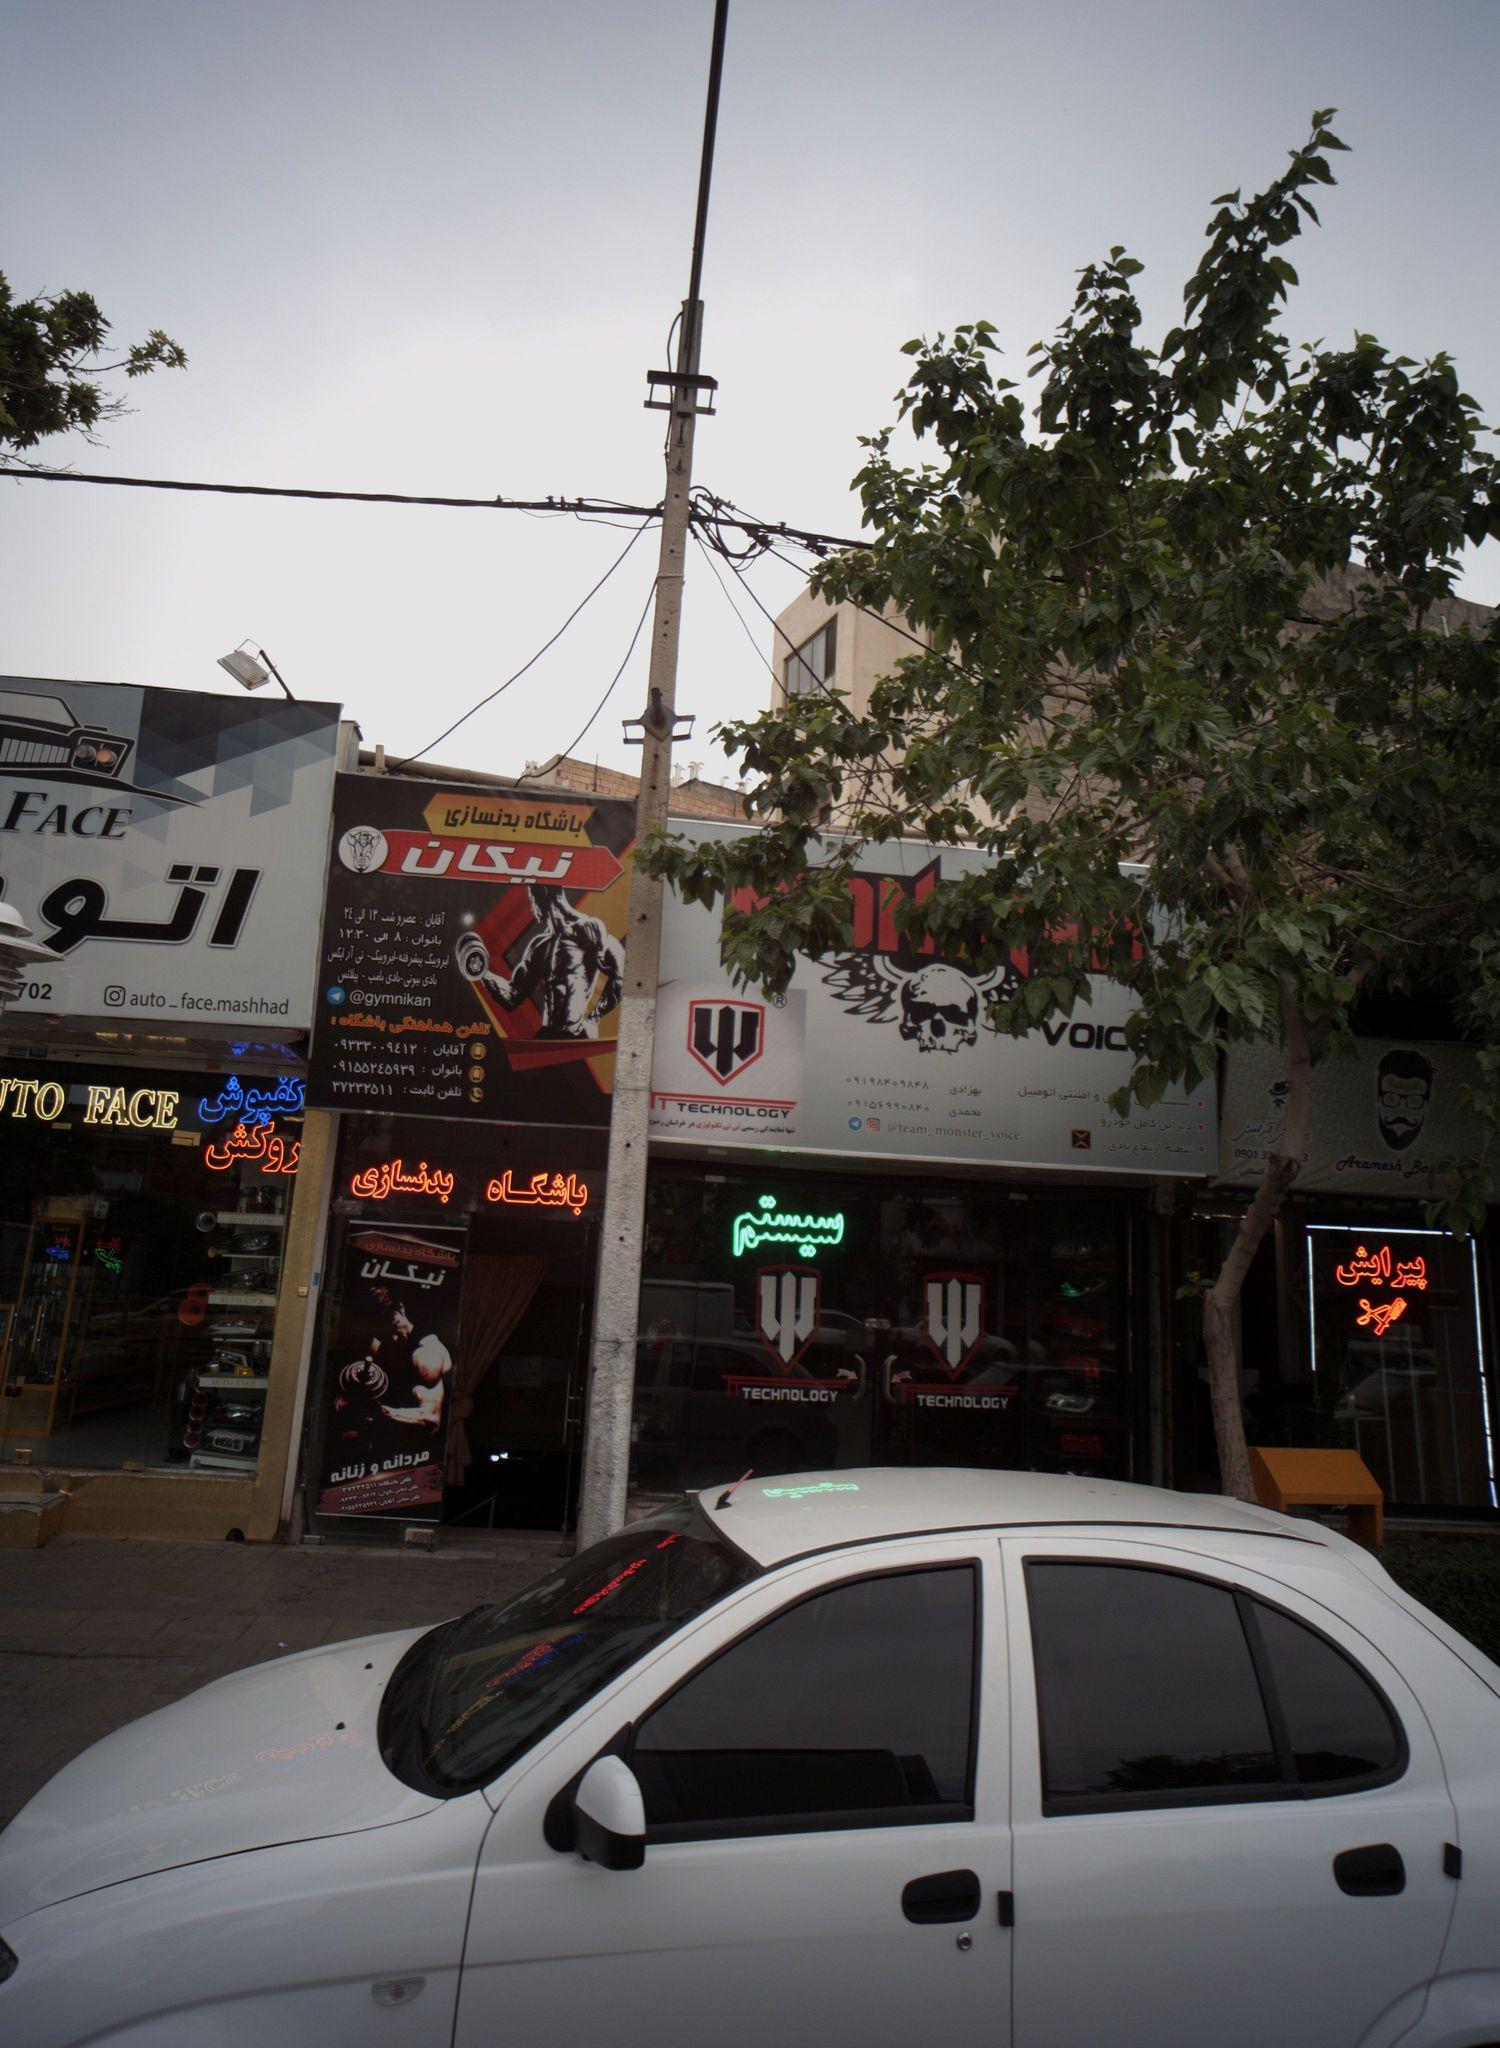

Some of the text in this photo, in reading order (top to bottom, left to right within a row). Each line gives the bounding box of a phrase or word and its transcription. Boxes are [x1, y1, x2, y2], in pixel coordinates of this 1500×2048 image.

[0, 790, 133, 839] FACE
[444, 805, 583, 838] باشگاه بدنسازی
[400, 840, 574, 885] نیکان
[41, 863, 262, 960] اتو
[354, 908, 366, 925] الی
[425, 911, 446, 928] آقایان
[373, 932, 389, 943] الی
[393, 931, 402, 942] ۸
[411, 934, 442, 948] بانوان
[349, 989, 431, 1008] @gymnikan
[338, 1012, 491, 1039] تلفن هماهنگی باشگاه
[1042, 1020, 1146, 1052] VOIC
[433, 1043, 467, 1058] آقایان
[431, 1064, 463, 1079] بانوان
[332, 1081, 462, 1100] تلفن ثابت ۳۷۲۳۲۵۱۱
[84, 1085, 179, 1129] FACE
[676, 1102, 791, 1120] TECHNOLOGY
[350, 1158, 589, 1217] باشگاه بدنسازی
[733, 1194, 845, 1259] سیستم
[360, 1258, 447, 1290] نیکان
[1336, 1245, 1429, 1291] پیرایش
[742, 1386, 839, 1404] TECHNOLOGY
[916, 1393, 1010, 1411] TECHNOLOGY
[330, 1450, 431, 1483] مردانه و زنانه
